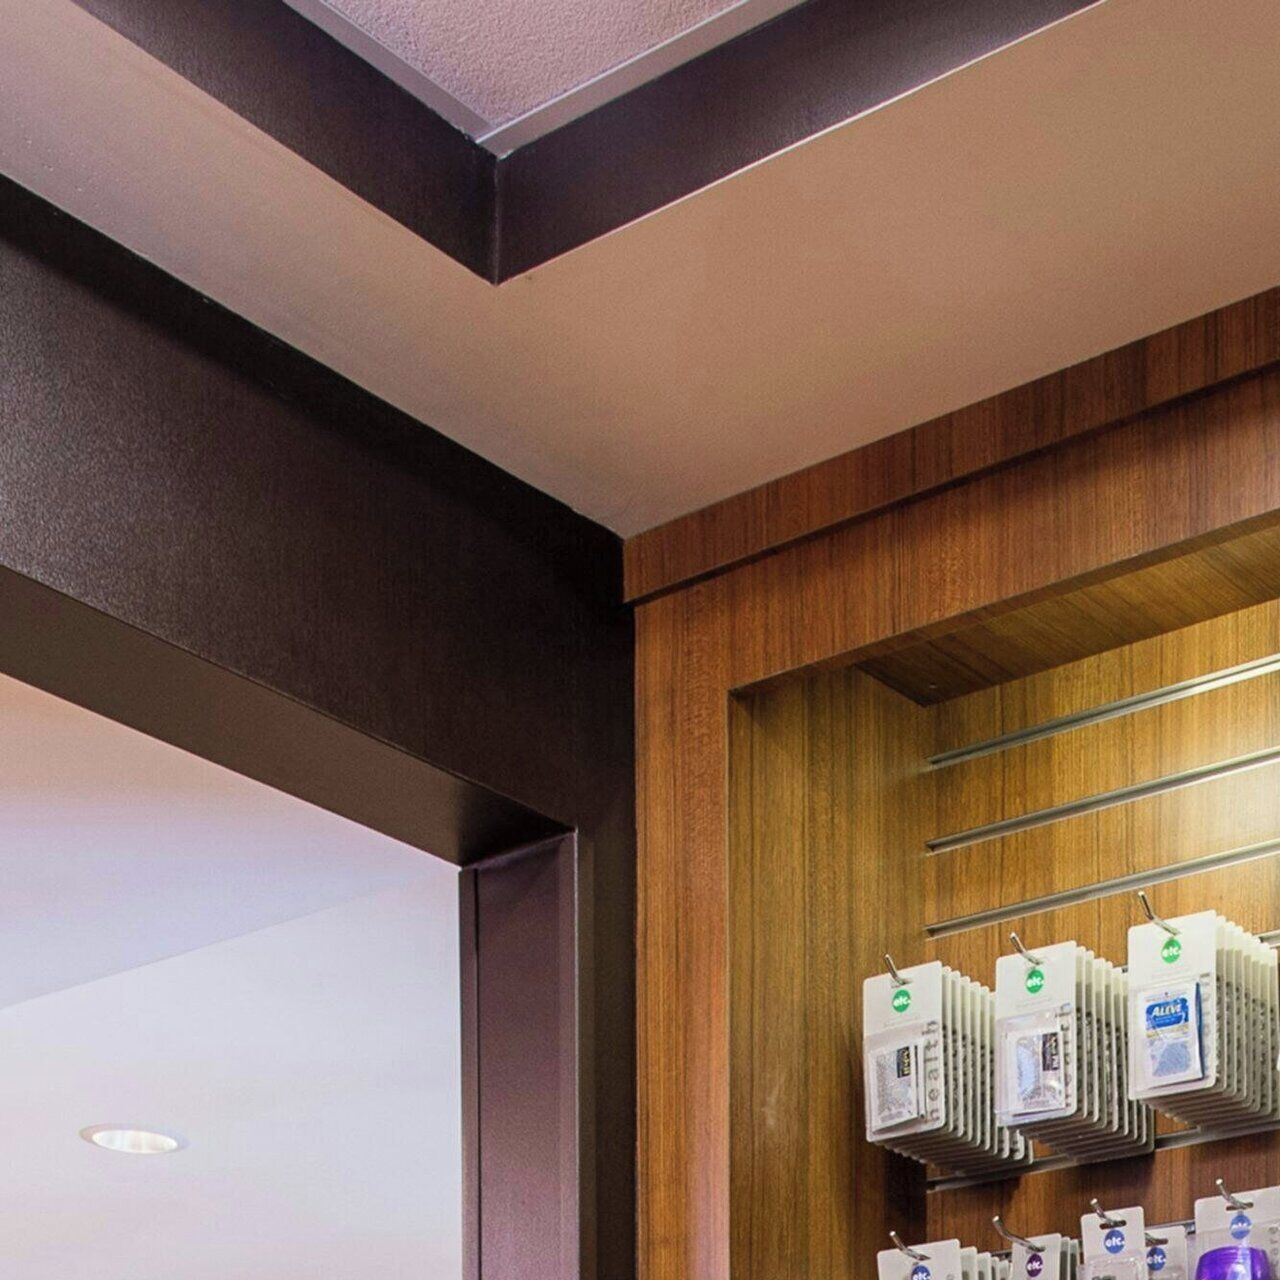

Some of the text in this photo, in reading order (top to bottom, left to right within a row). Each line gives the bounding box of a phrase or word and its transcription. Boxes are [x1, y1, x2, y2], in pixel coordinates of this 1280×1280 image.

[1162, 946, 1182, 959] etc.
[1026, 974, 1045, 987] etc.
[892, 994, 911, 1008] etc.
[923, 1021, 940, 1123] health
